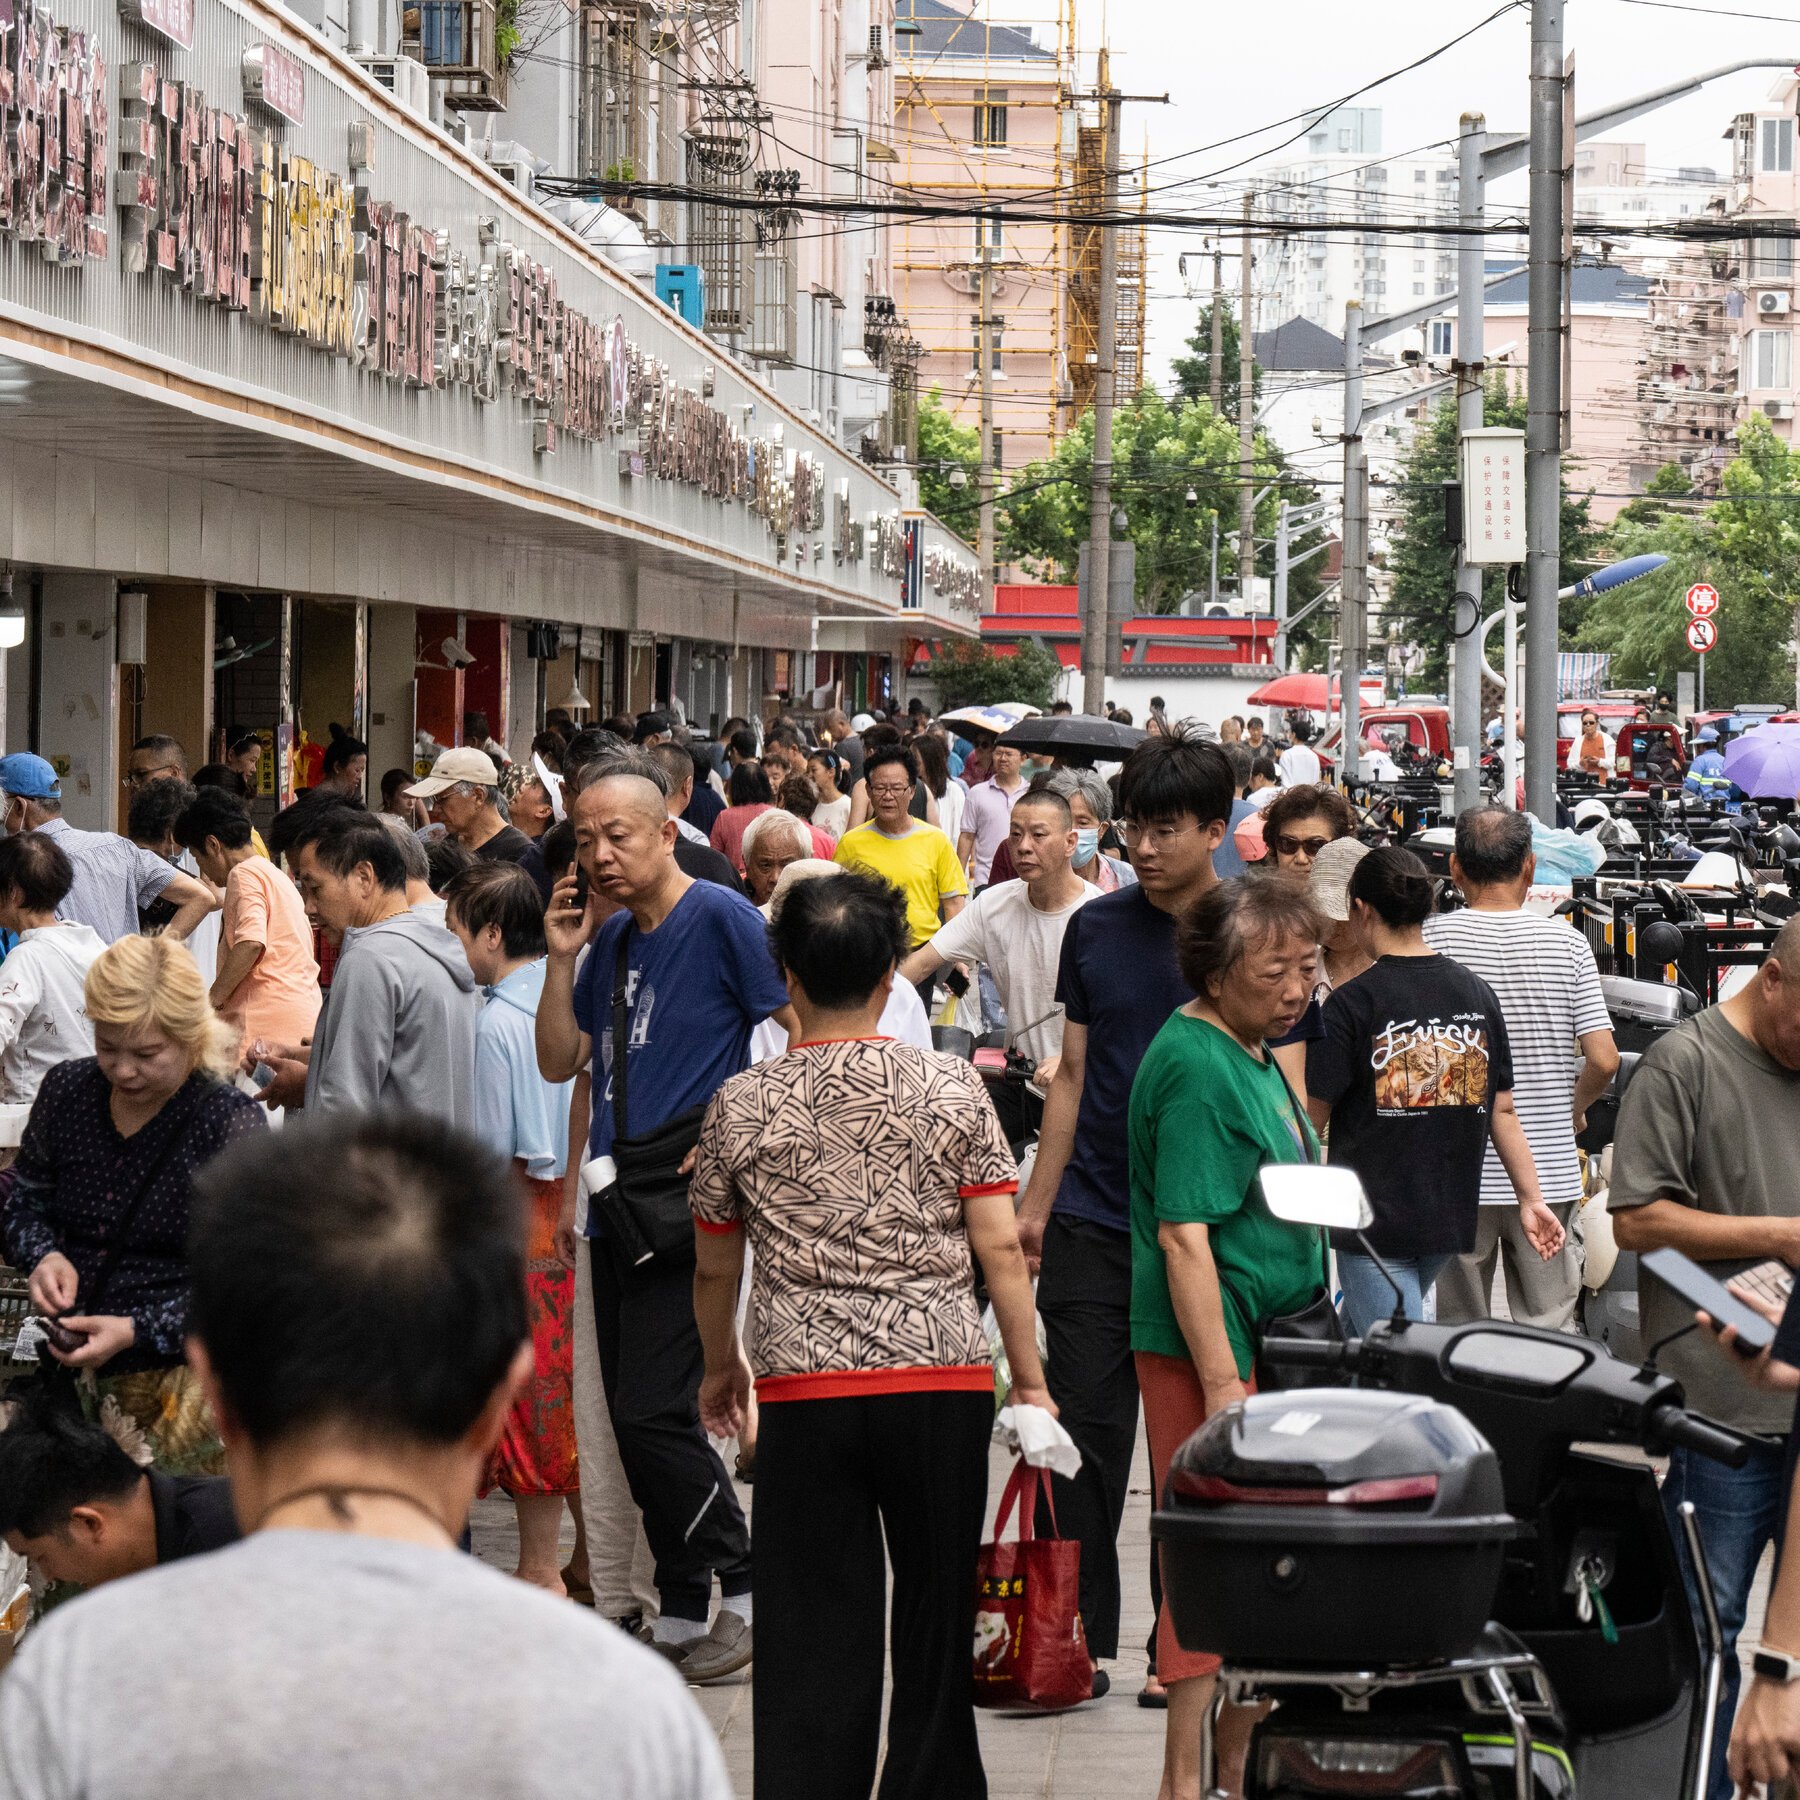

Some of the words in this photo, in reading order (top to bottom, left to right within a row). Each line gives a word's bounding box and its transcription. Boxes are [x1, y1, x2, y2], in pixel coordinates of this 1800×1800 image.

[1483, 455, 1493, 541] 保护交通设施
[1502, 455, 1512, 541] 保障交通安全
[1690, 587, 1715, 613] 停
